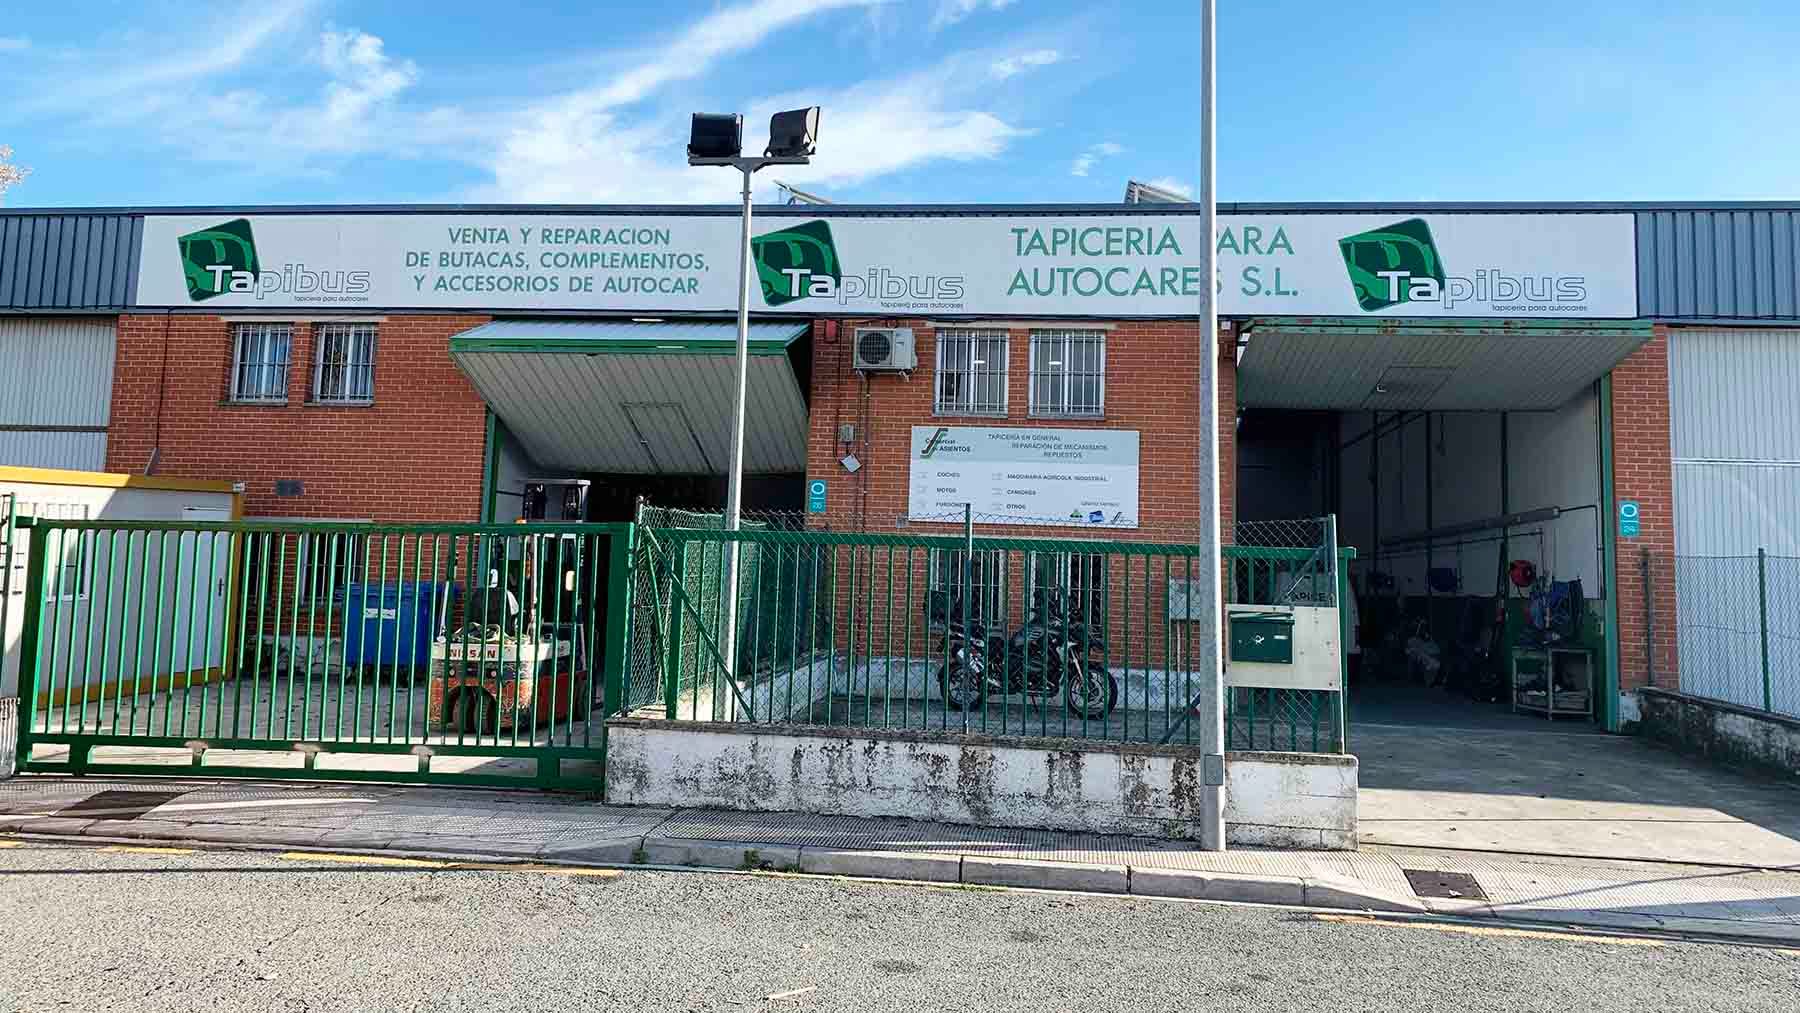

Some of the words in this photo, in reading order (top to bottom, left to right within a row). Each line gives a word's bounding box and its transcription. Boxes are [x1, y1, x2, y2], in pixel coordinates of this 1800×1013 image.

[448, 227, 510, 244] VENTA
[519, 227, 532, 244] Y
[541, 228, 671, 245] REPARACION
[1011, 226, 1182, 256] TAPICERIA
[1216, 226, 1295, 255] ARA
[405, 251, 430, 267] DE
[439, 251, 530, 270] BUTACAS,
[540, 252, 710, 272] COMPLEMENTOS,
[205, 263, 370, 300] Tapibus
[413, 275, 425, 291] Y
[433, 275, 560, 292] ACCESORIOS
[569, 276, 593, 292] DE
[603, 276, 699, 293] AUTOCAR
[781, 267, 964, 305] Tapibus
[1241, 266, 1299, 296] S.L.
[1376, 269, 1586, 309] Tapibus
